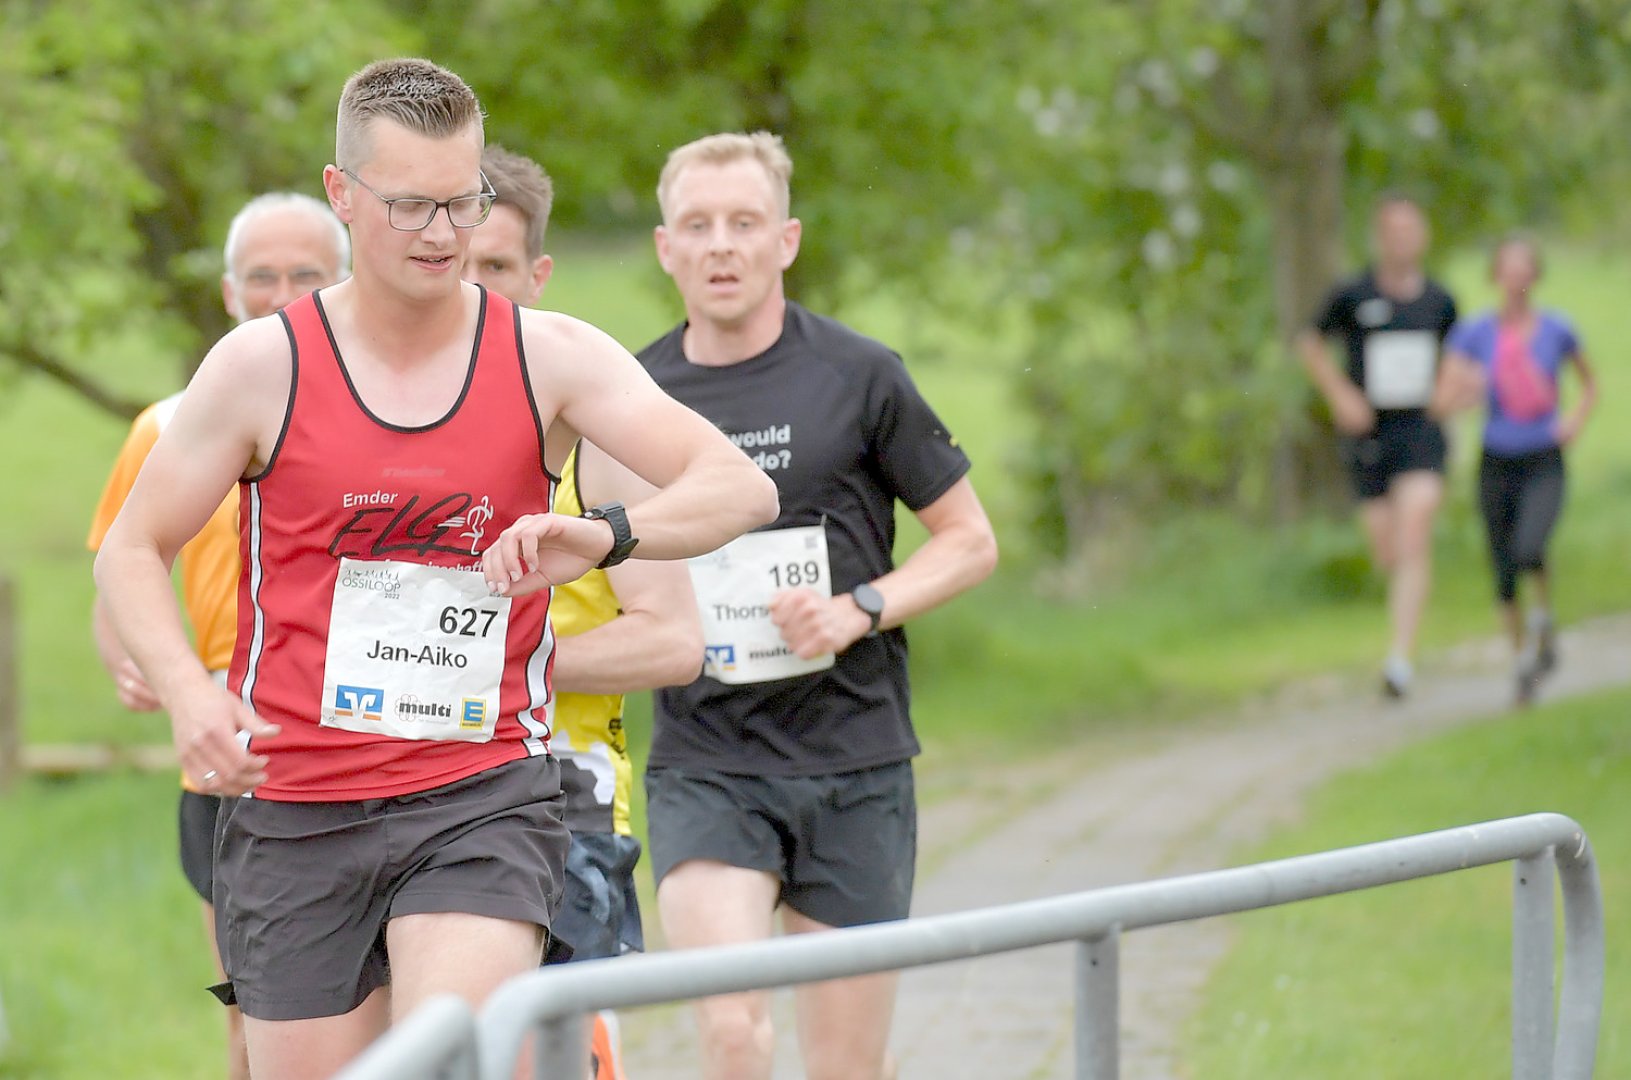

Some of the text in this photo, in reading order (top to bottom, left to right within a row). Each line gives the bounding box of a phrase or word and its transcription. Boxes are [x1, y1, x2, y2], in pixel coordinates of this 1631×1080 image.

[343, 490, 398, 508] Emder
[769, 560, 819, 588] 189
[341, 577, 401, 593] OSSILOOP
[384, 592, 400, 600] 2022
[713, 604, 769, 620] Thors
[439, 605, 499, 638] 627
[366, 640, 468, 669] Jan-Aiko
[749, 646, 793, 660] mult
[398, 702, 452, 718] multi
